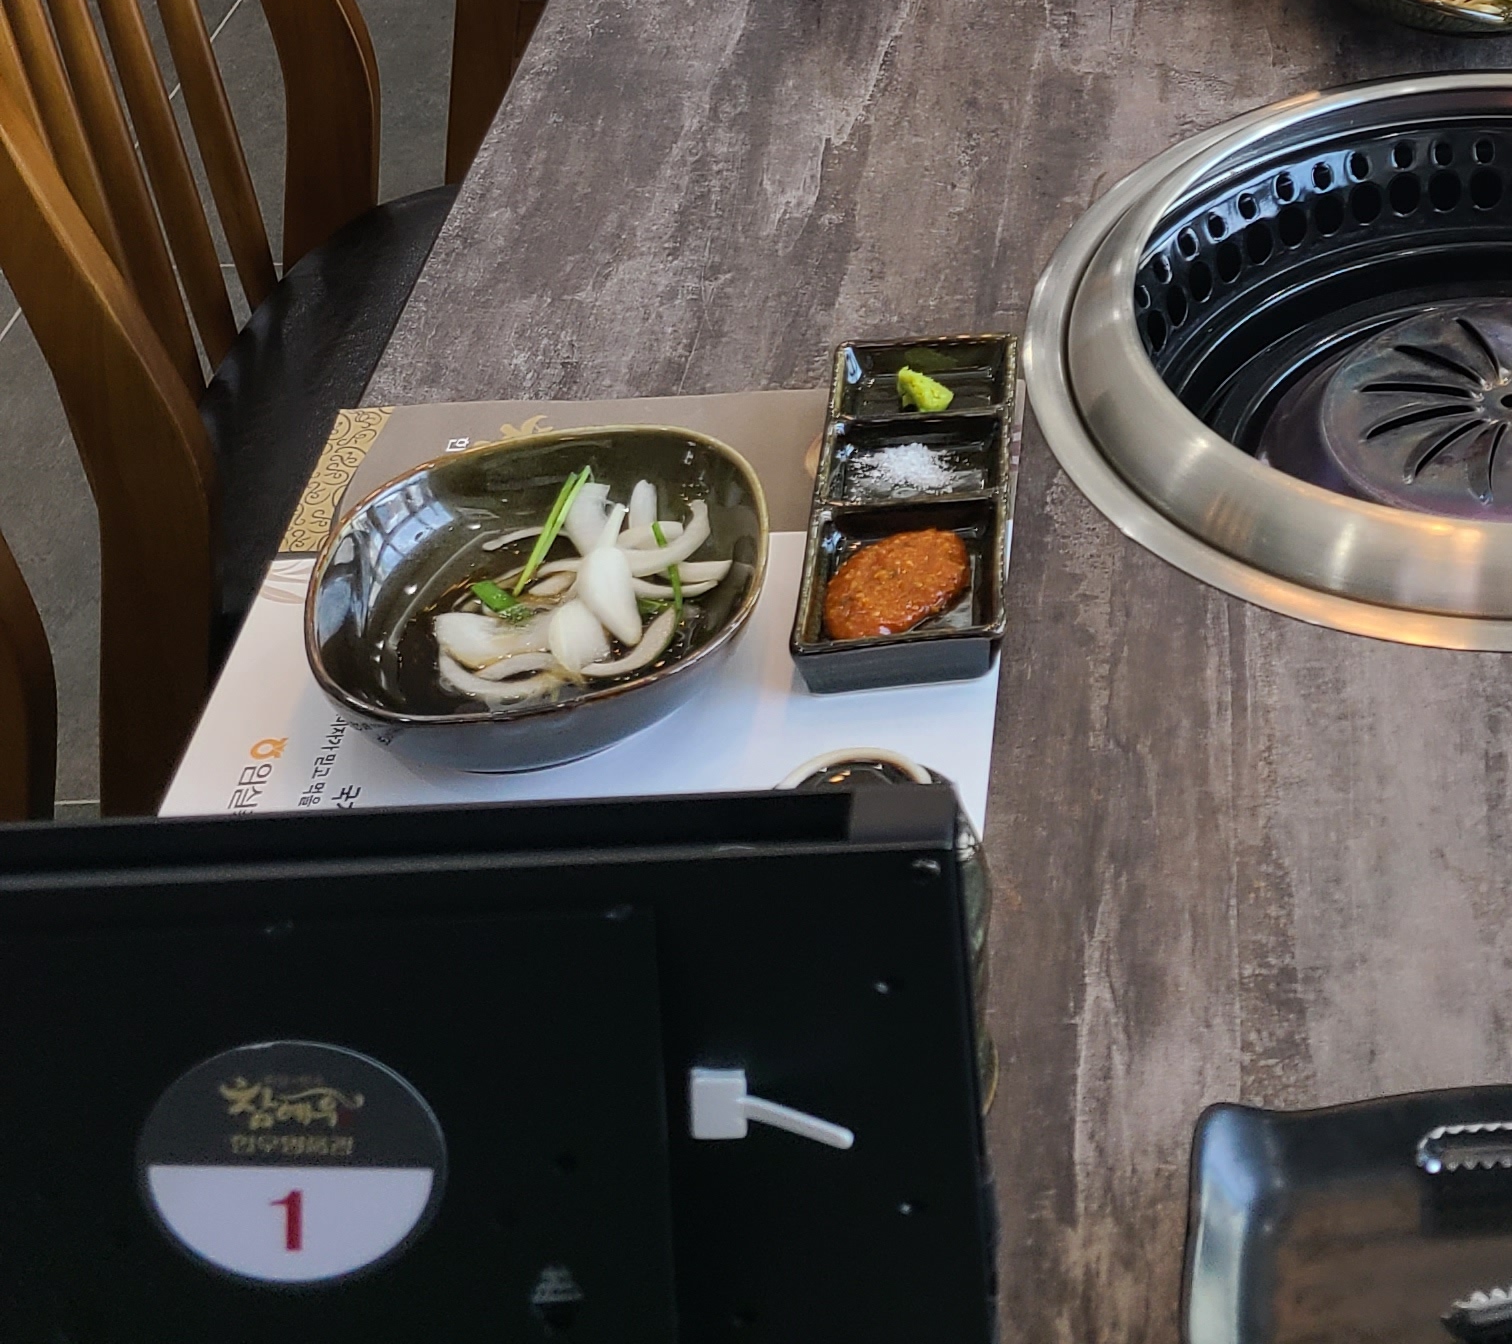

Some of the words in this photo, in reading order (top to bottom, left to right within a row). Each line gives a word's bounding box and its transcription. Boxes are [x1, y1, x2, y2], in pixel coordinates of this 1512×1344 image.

[312, 753, 336, 780] 믿고
[297, 782, 326, 808] 먹을
[268, 1189, 305, 1253] 1
